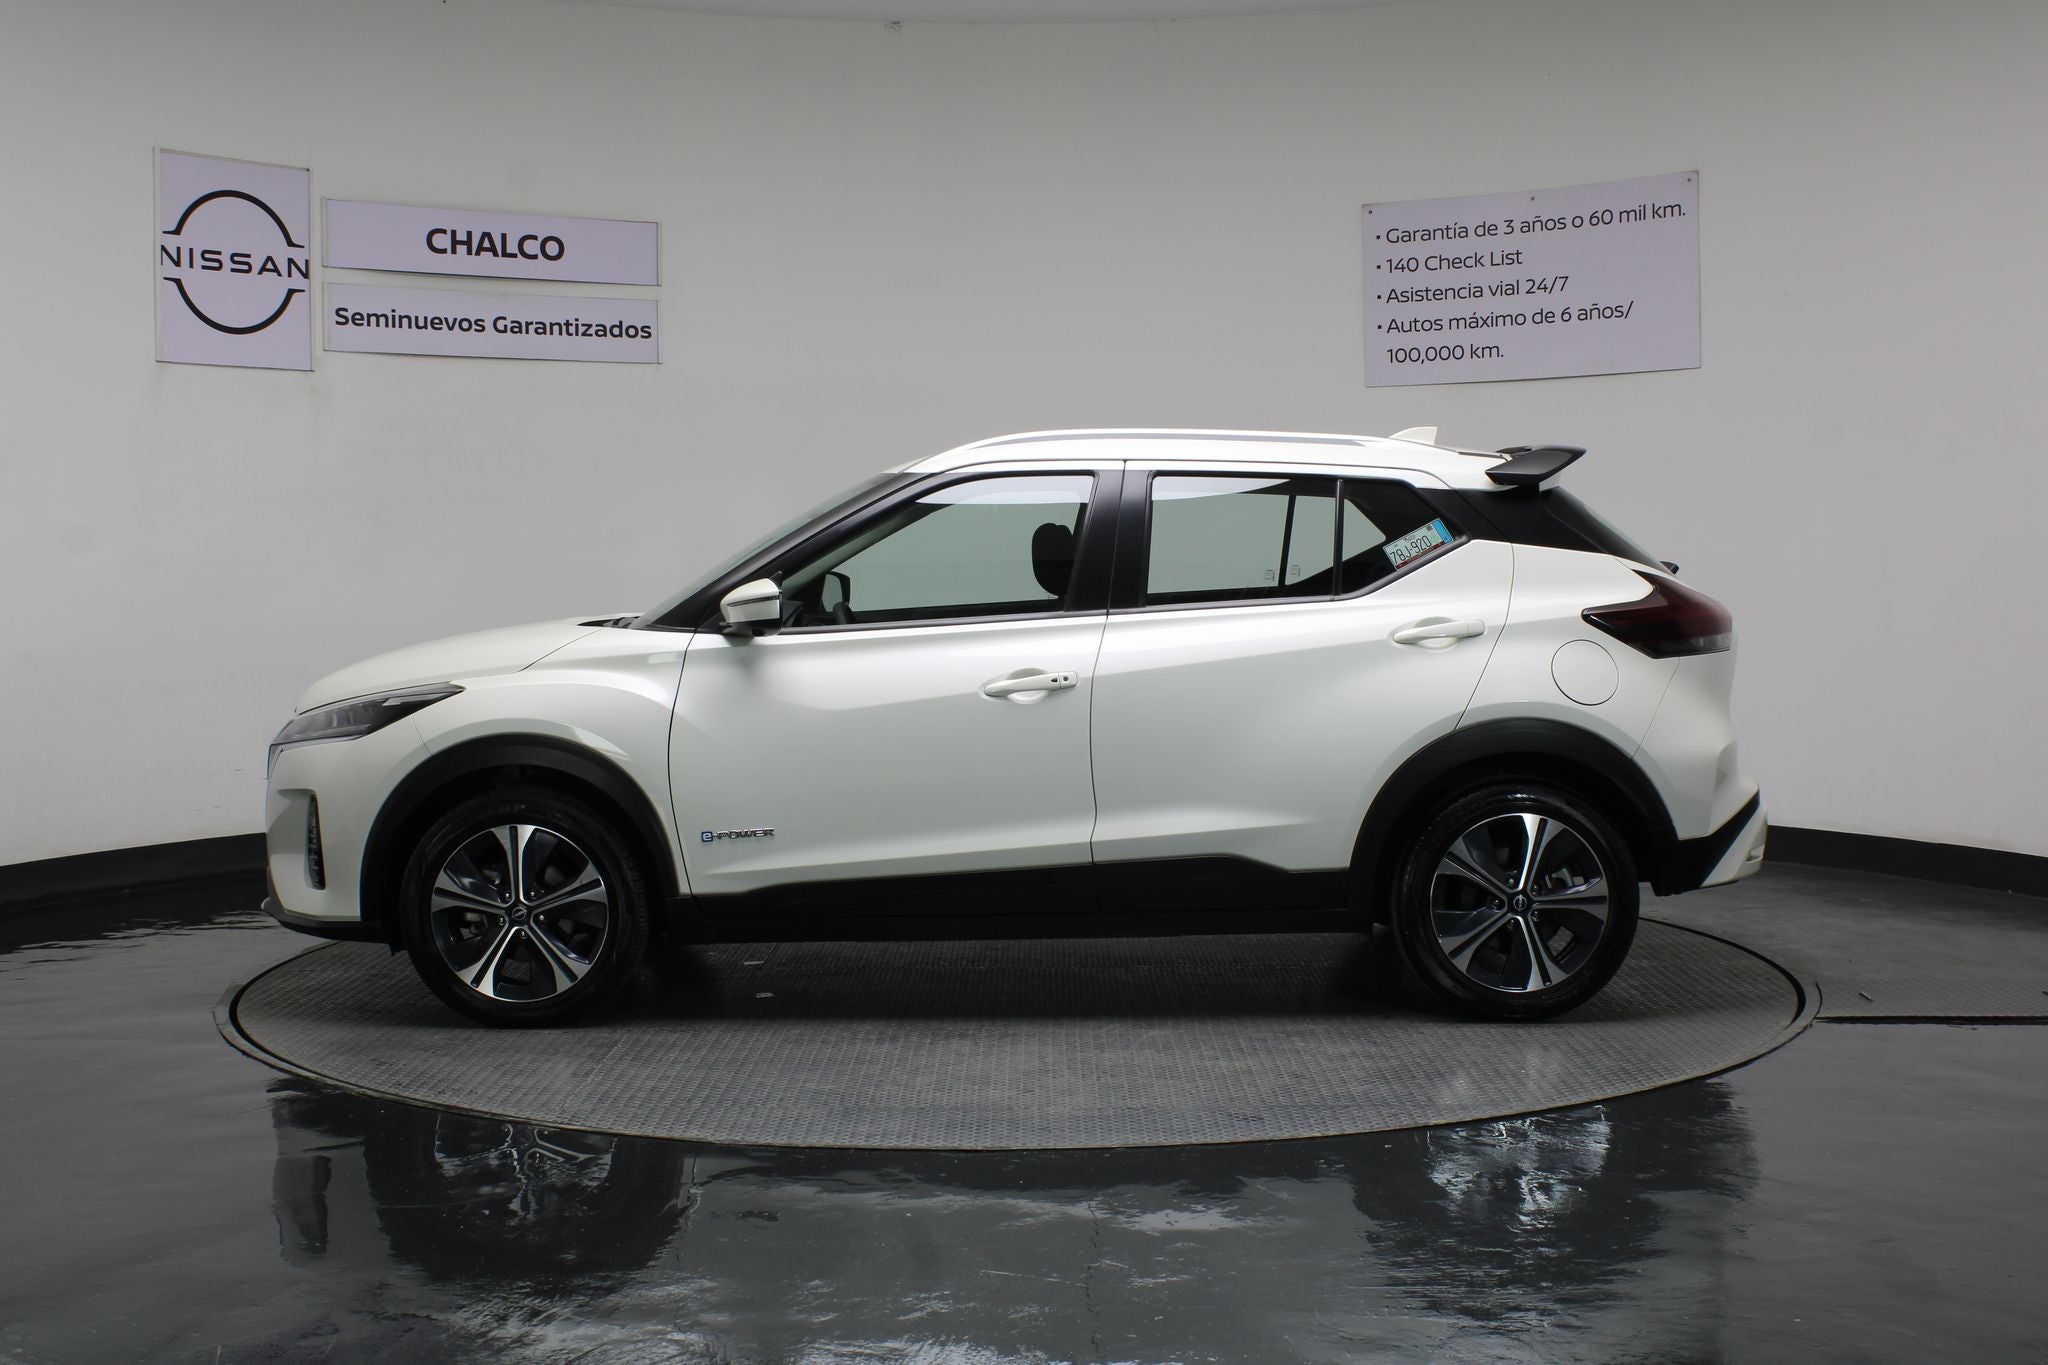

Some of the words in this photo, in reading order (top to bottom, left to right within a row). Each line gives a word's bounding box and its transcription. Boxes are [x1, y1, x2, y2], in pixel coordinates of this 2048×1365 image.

[1385, 221, 1469, 244] Garantía
[1473, 220, 1499, 238] de
[1503, 218, 1515, 236] 3
[1519, 215, 1567, 234] años
[1571, 215, 1585, 229] o
[1588, 208, 1614, 227] 60
[1618, 203, 1647, 224] mil
[1651, 202, 1687, 220] km.
[425, 227, 566, 262] CHALCO
[1386, 256, 1419, 274] 140
[1424, 251, 1485, 271] Check
[1489, 249, 1523, 267] List
[160, 244, 310, 280] NISSAN
[1385, 282, 1484, 304] Asistencia
[1487, 279, 1520, 297] vial
[1525, 275, 1570, 295] 24/7
[334, 306, 486, 334] Seminuevos
[492, 315, 653, 340] Garantizados
[1386, 317, 1444, 334] Autos
[1448, 311, 1527, 331] máximo
[1531, 307, 1556, 325] de
[1560, 306, 1572, 323] 6
[1577, 300, 1635, 322] años/
[1386, 344, 1465, 365] 100,000
[1470, 343, 1504, 360] km.
[1390, 535, 1432, 564] 78J-920
